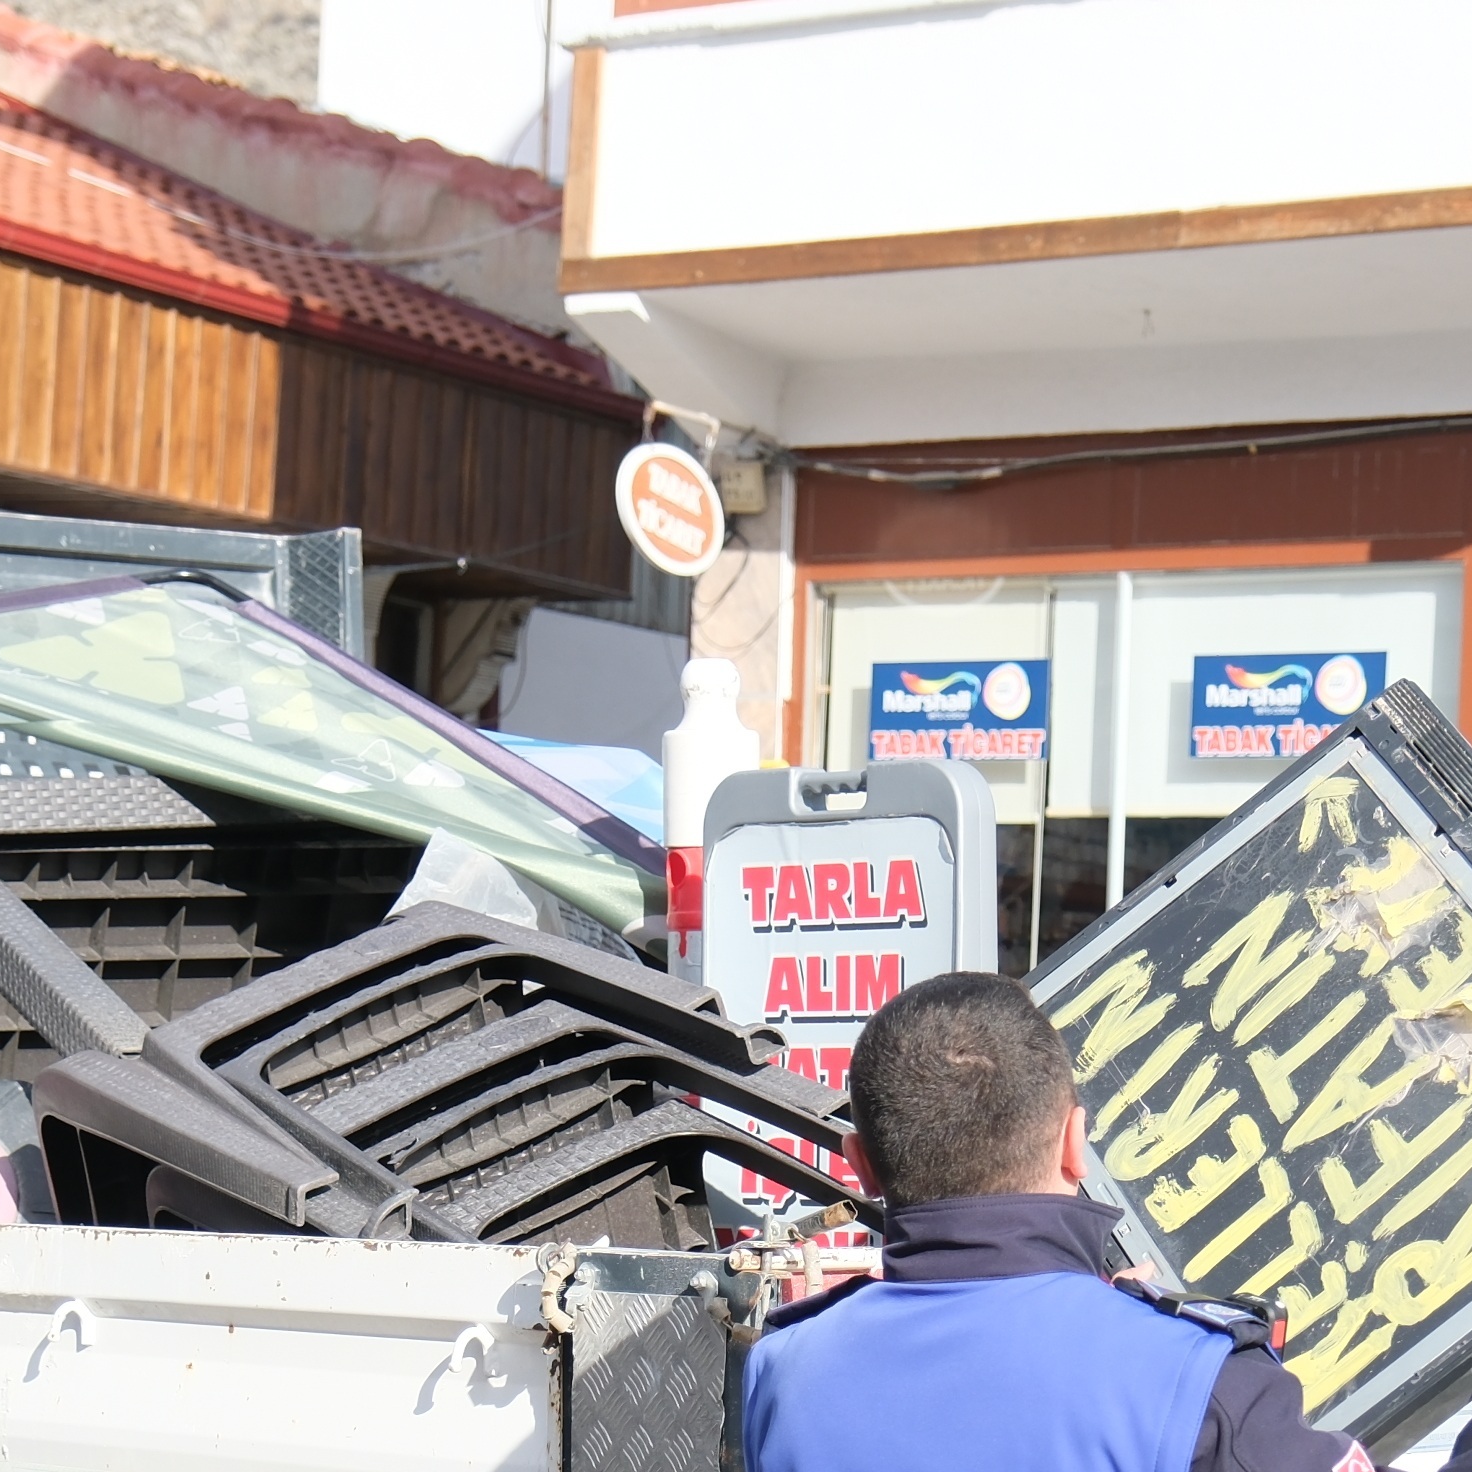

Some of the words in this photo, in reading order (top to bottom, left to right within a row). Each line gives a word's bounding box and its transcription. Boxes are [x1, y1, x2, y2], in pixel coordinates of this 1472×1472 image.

[882, 689, 972, 713] Marshall
[1205, 684, 1302, 708] Marshall
[871, 729, 947, 760] TABAK
[948, 722, 1046, 760] TİCARET
[1192, 725, 1275, 758] TABAK
[741, 858, 926, 928] TARLA
[763, 952, 903, 1016] ALIM
